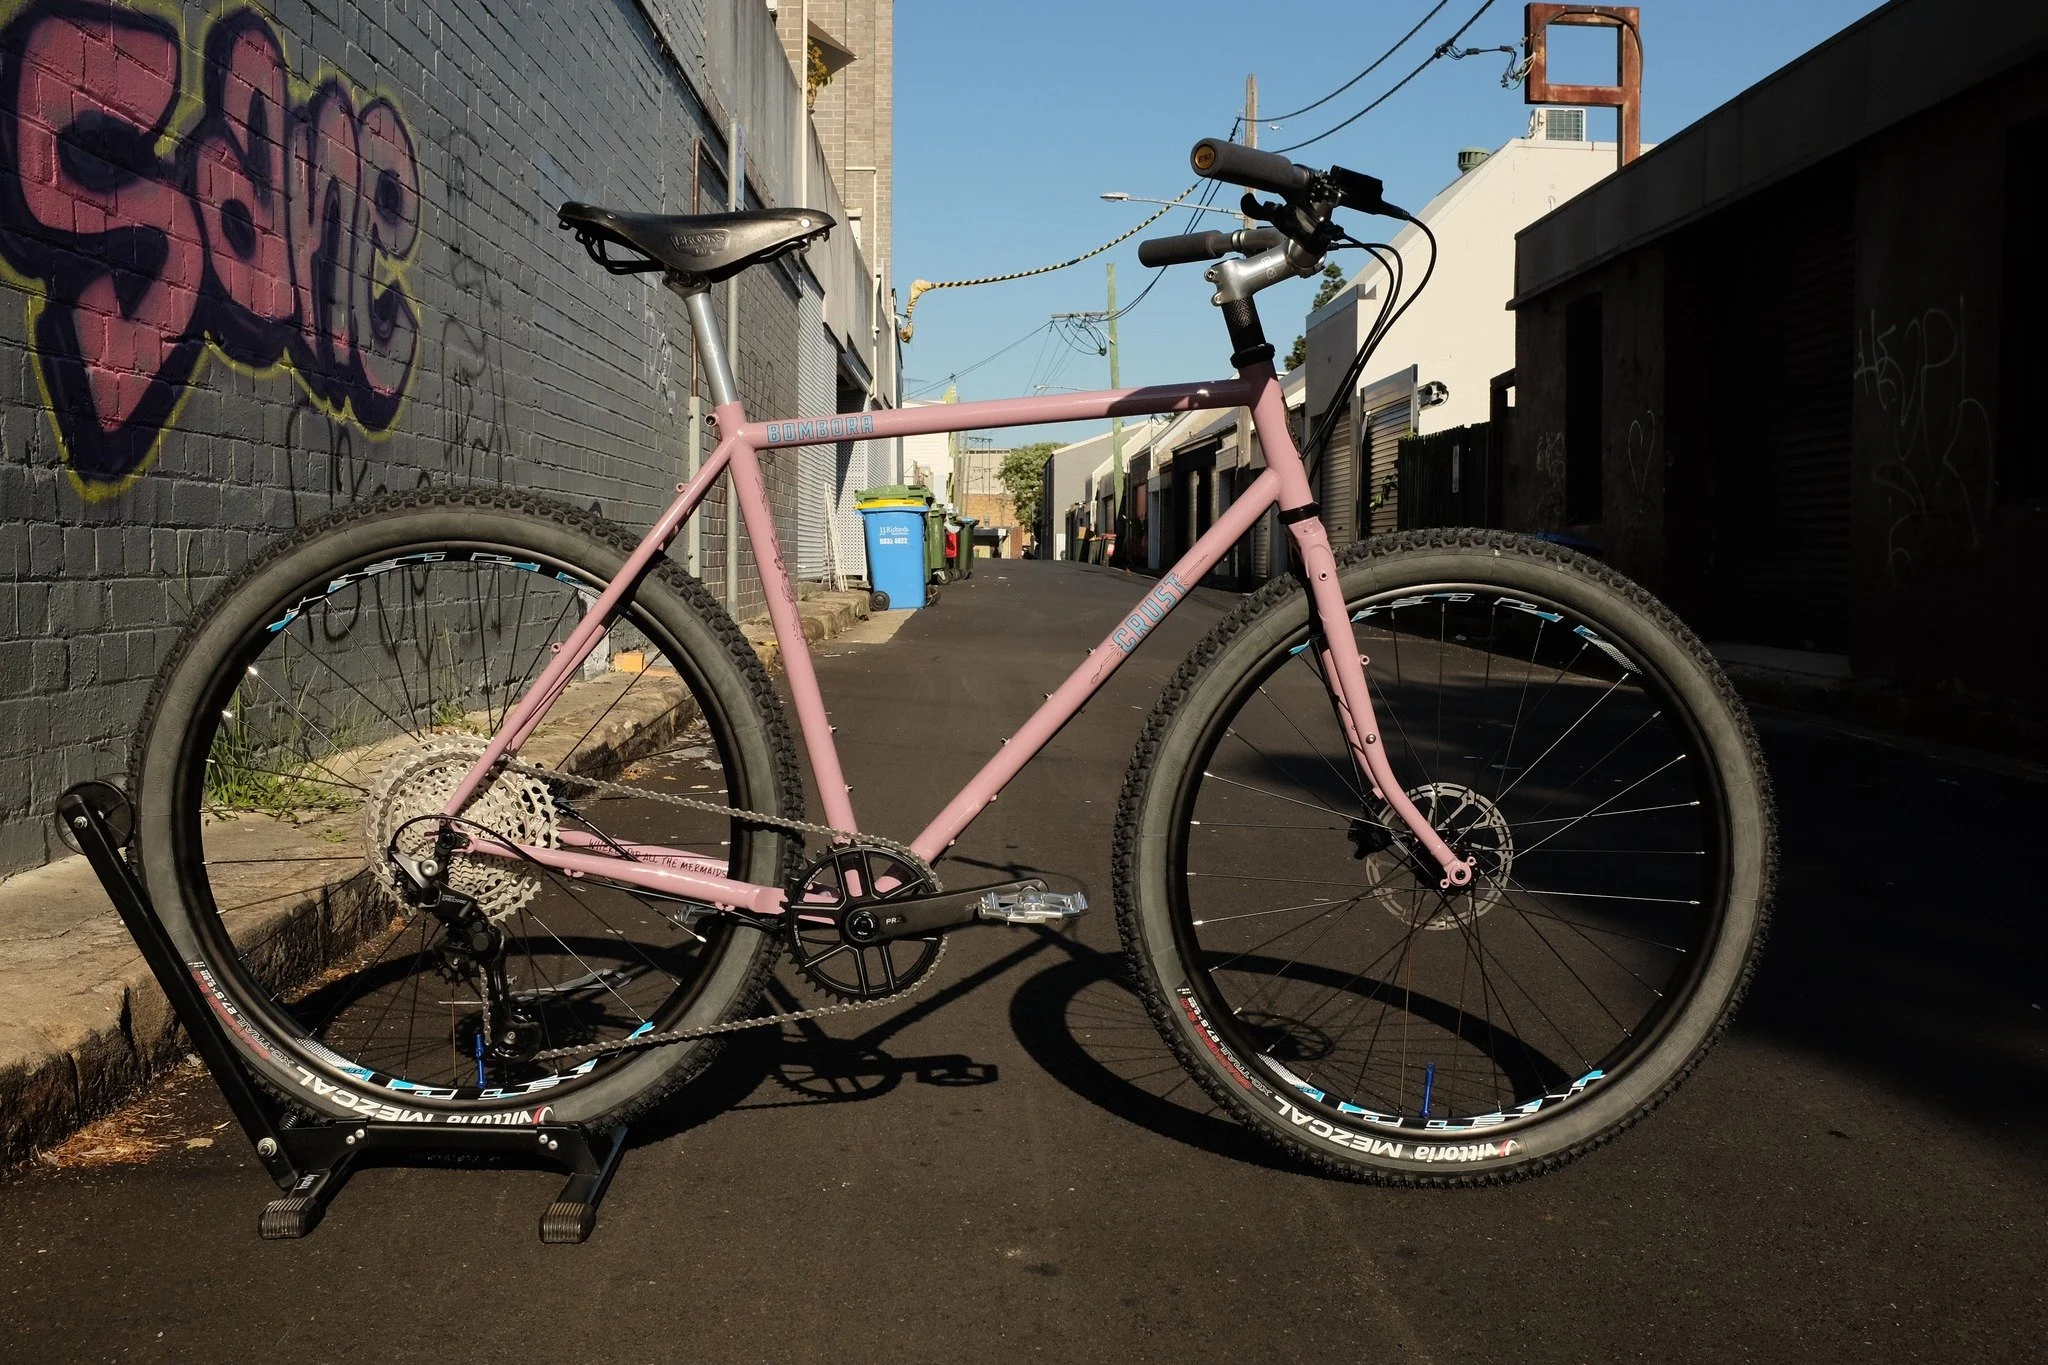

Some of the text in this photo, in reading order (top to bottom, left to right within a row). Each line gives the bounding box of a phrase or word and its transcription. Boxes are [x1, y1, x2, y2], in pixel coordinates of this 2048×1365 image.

[767, 415, 873, 443] BOMBORA
[1112, 572, 1186, 652] CRUST
[643, 853, 659, 864] ALL
[662, 856, 677, 869] THE
[680, 860, 728, 879] MERMAIDS
[293, 1066, 433, 1123] MEZCAL
[1273, 1095, 1403, 1158] MEZCAL
